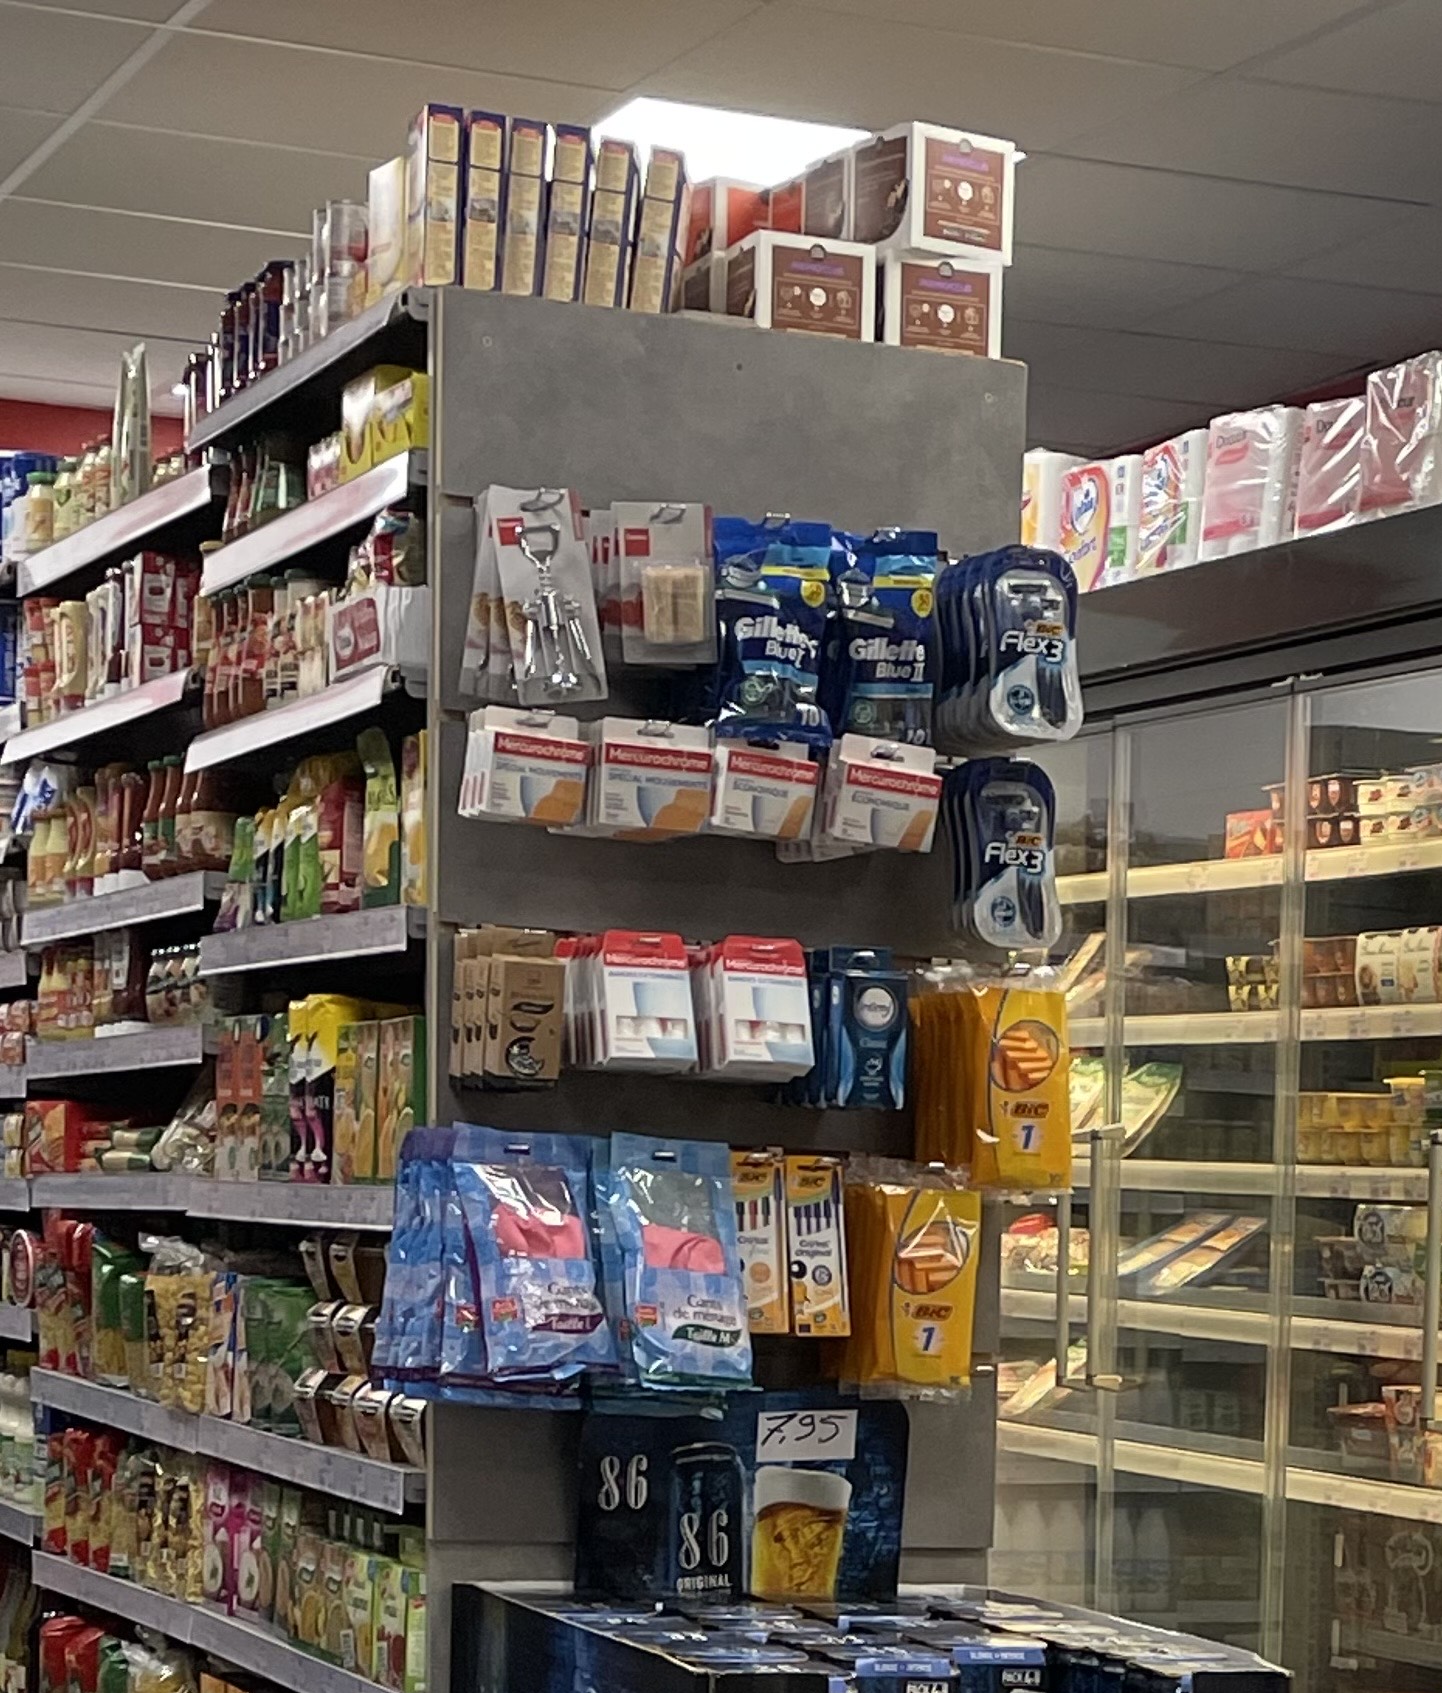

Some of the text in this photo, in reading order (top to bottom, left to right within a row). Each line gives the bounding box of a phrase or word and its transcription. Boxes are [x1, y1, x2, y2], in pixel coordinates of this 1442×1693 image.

[848, 636, 926, 663] Gillette
[875, 661, 909, 680] Blue
[1014, 1102, 1050, 1118] BIC
[1020, 1124, 1036, 1151] 1
[913, 1304, 952, 1320] BIC
[920, 1326, 936, 1352] 1
[761, 1411, 848, 1447] 7,95
[676, 1572, 734, 1592] ORIGINAL
